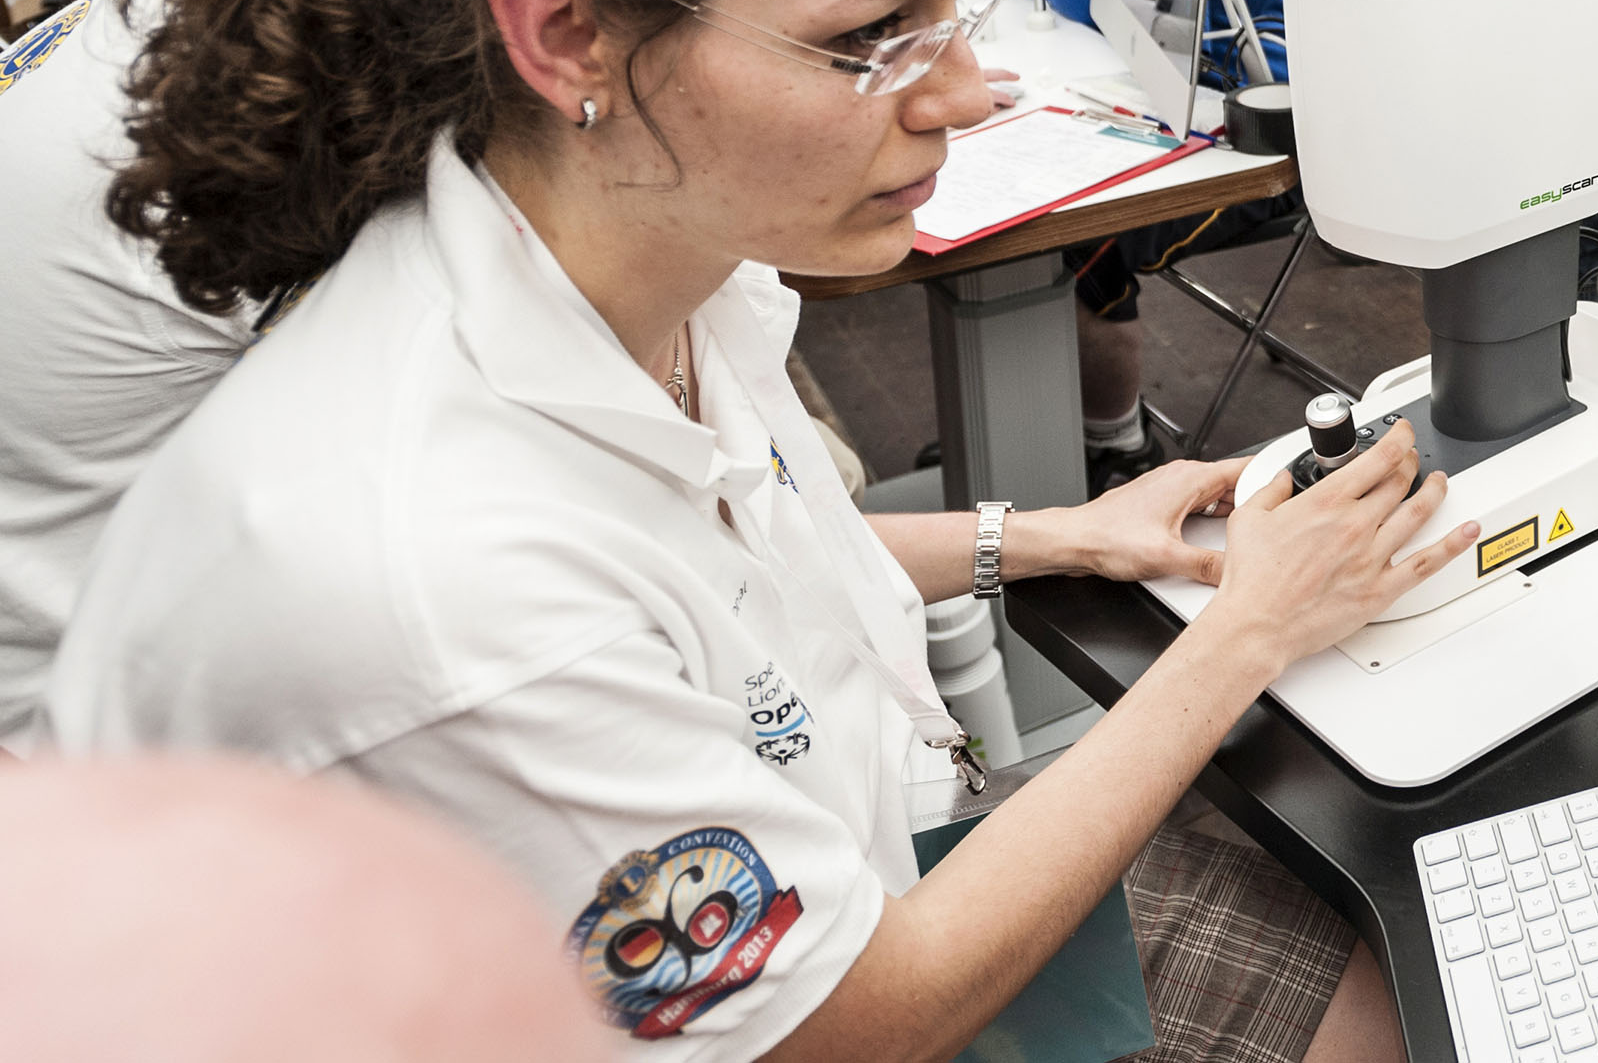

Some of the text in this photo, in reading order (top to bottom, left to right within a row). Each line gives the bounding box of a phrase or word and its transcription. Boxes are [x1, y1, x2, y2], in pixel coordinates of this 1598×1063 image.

[1486, 538, 1530, 563] LASER PRODUCT
[1497, 538, 1516, 550] CLASS
[667, 831, 758, 867] CONVENTION
[657, 967, 743, 1026] Hamburg
[737, 926, 774, 970] 2013
